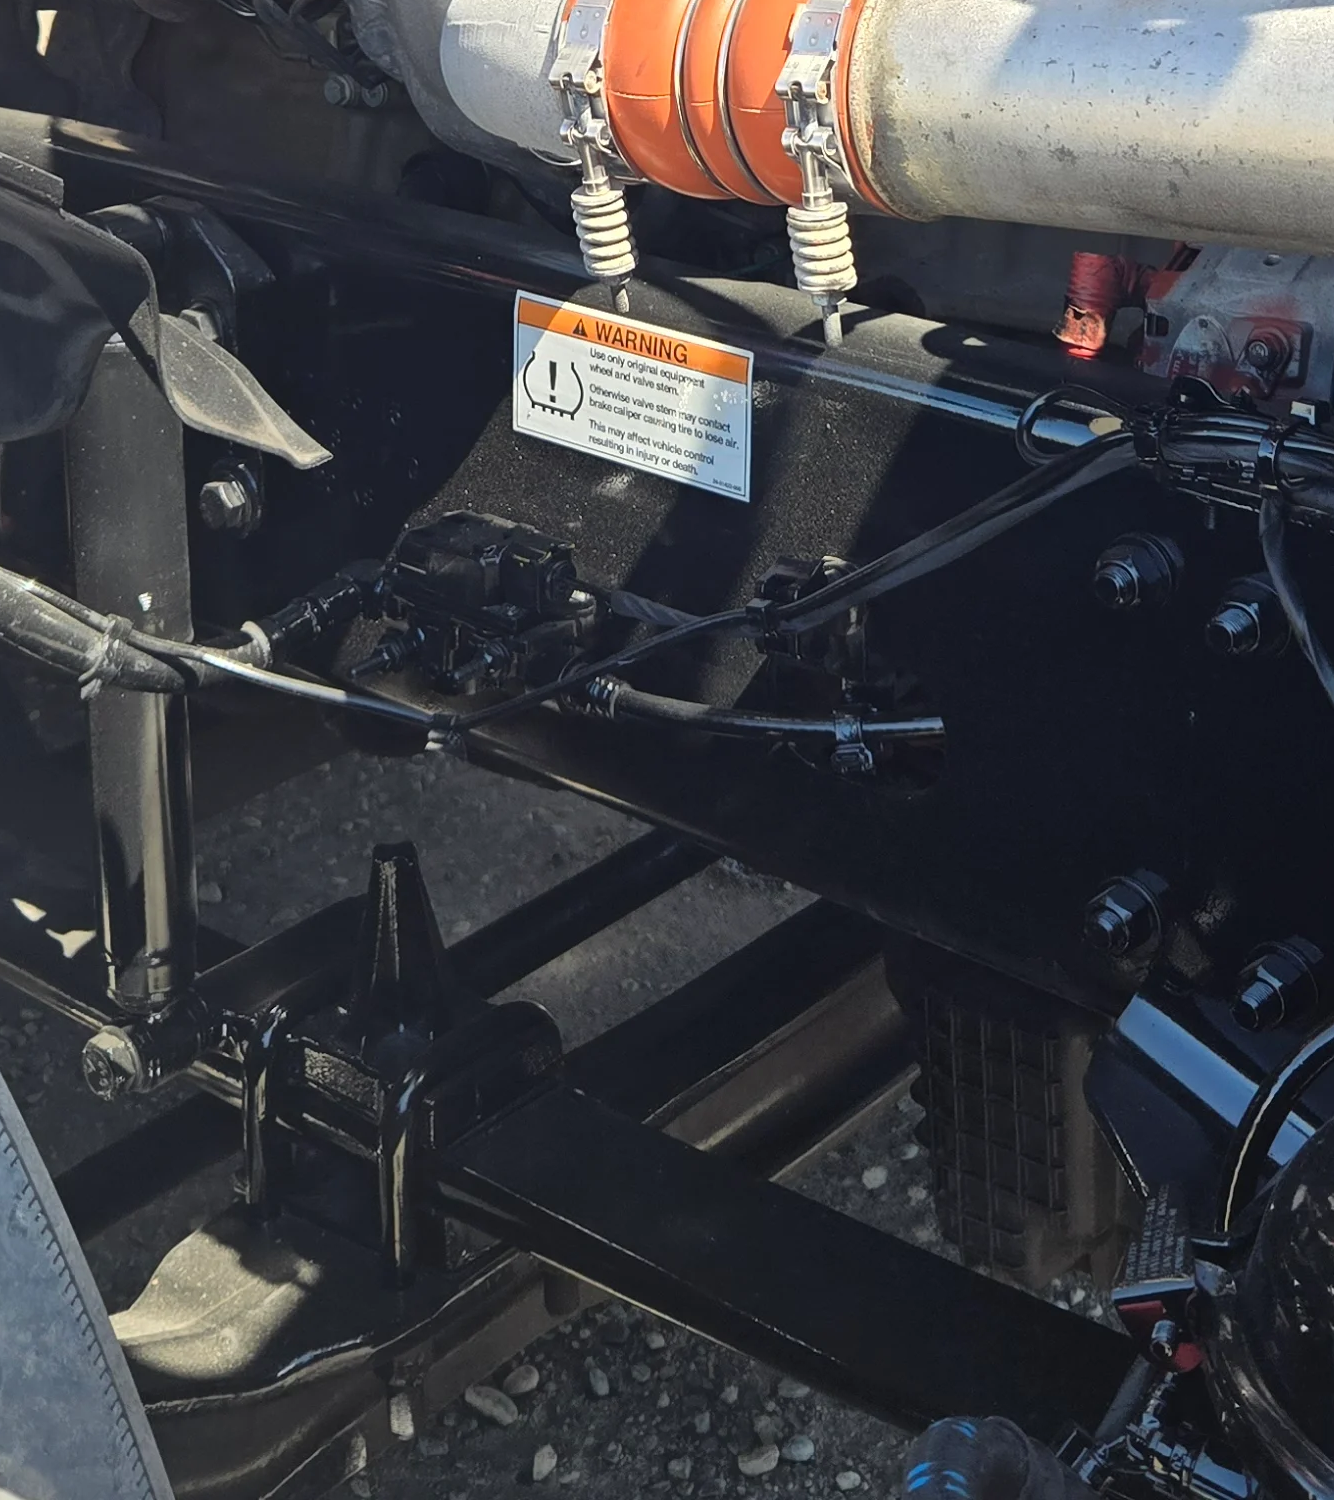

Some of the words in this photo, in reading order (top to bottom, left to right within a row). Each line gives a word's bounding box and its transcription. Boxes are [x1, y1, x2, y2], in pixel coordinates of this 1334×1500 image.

[589, 347, 606, 360] Use
[607, 354, 626, 368] only
[627, 360, 659, 375] original
[595, 320, 688, 365] WARNING
[589, 363, 613, 377] wheel
[614, 370, 631, 382] and
[633, 375, 655, 389] valve
[656, 381, 680, 396] stem.
[589, 383, 631, 404] Otherwise
[632, 396, 655, 411] valve
[656, 403, 677, 417] stem
[678, 411, 698, 426] may
[698, 416, 731, 434] contact
[589, 396, 613, 412] brake
[613, 406, 642, 421] caliper
[643, 413, 677, 434] causing
[678, 422, 693, 436] tire
[694, 428, 703, 440] to
[705, 430, 724, 446] lose
[725, 437, 740, 450] air.
[588, 418, 606, 433] This
[607, 426, 626, 441] may
[627, 431, 651, 446] affect
[652, 440, 683, 456] vehicle
[683, 449, 715, 466] control
[588, 435, 625, 455] resulting
[626, 444, 635, 456] in
[635, 447, 660, 466] injury
[661, 457, 671, 467] or
[672, 459, 699, 476] death.
